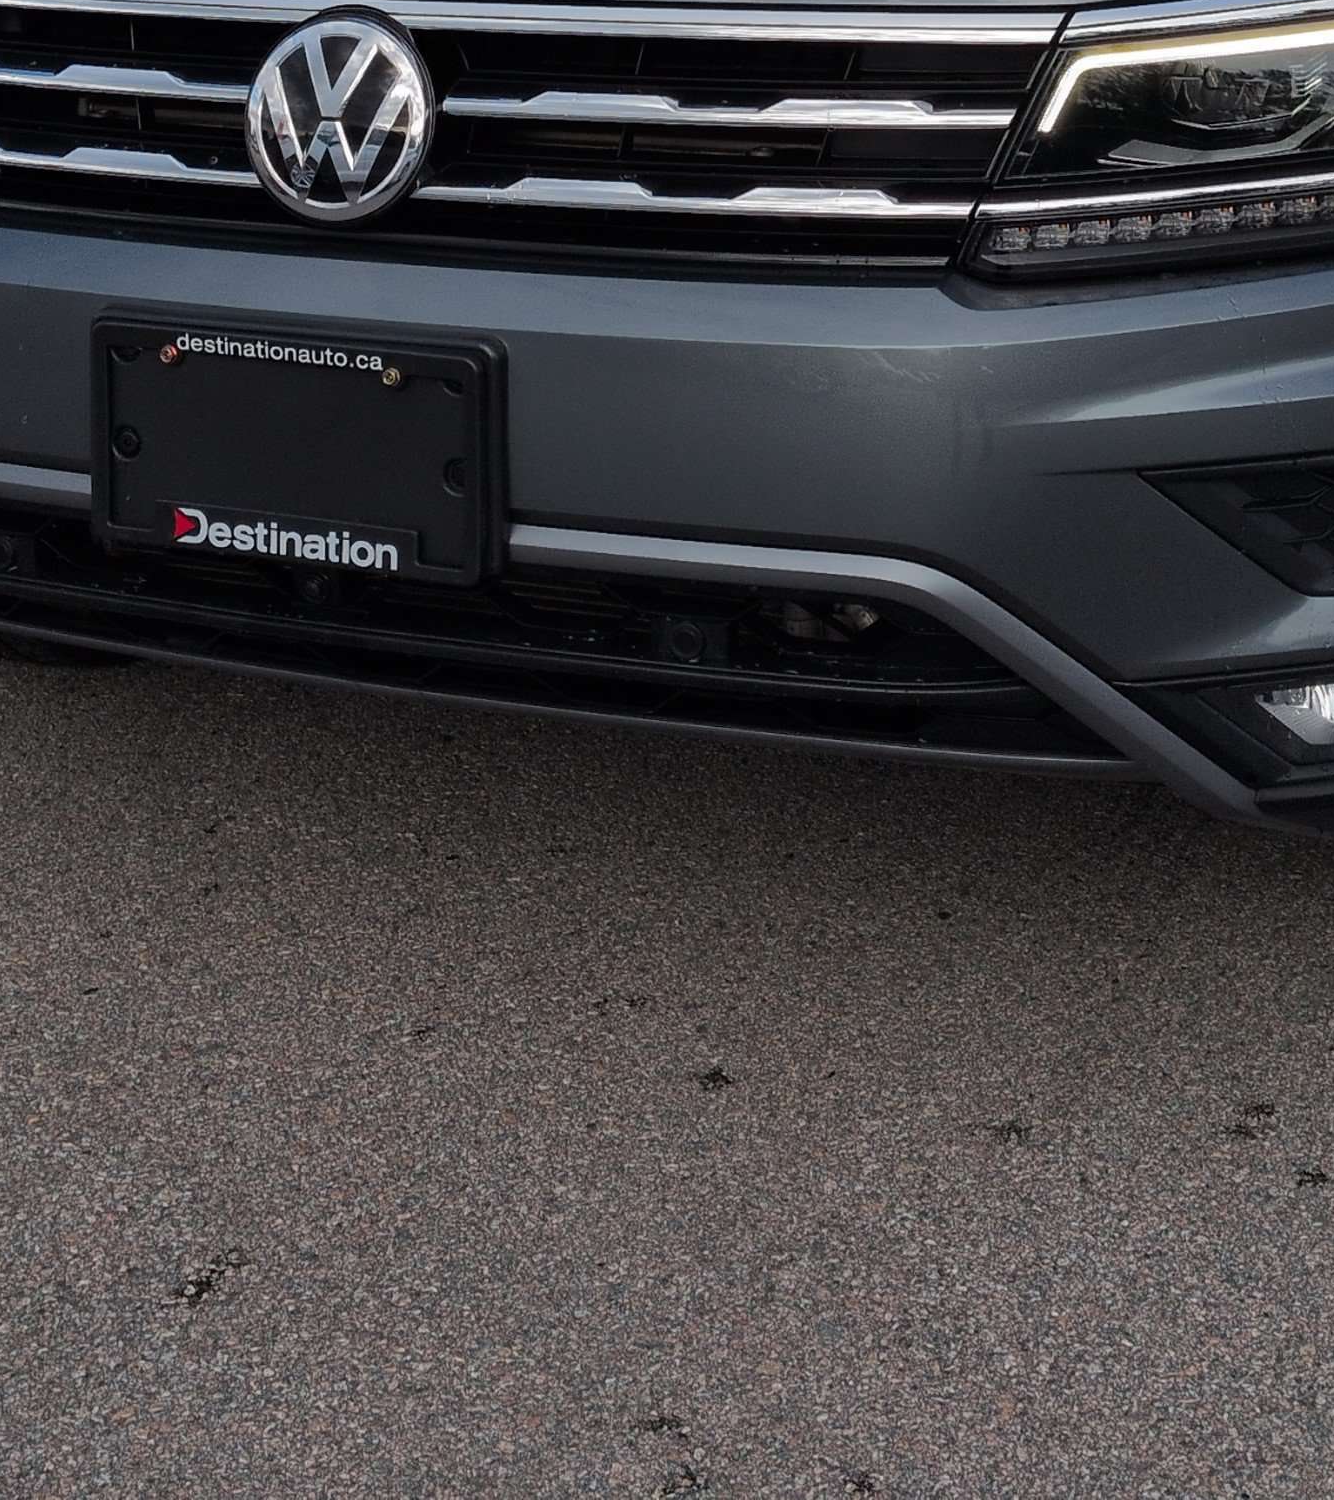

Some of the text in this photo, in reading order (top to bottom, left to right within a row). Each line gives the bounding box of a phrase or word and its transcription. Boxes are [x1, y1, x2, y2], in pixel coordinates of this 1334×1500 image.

[257, 24, 419, 210] VW
[176, 333, 384, 371] destinationauto.ca
[175, 507, 399, 571] Destination
